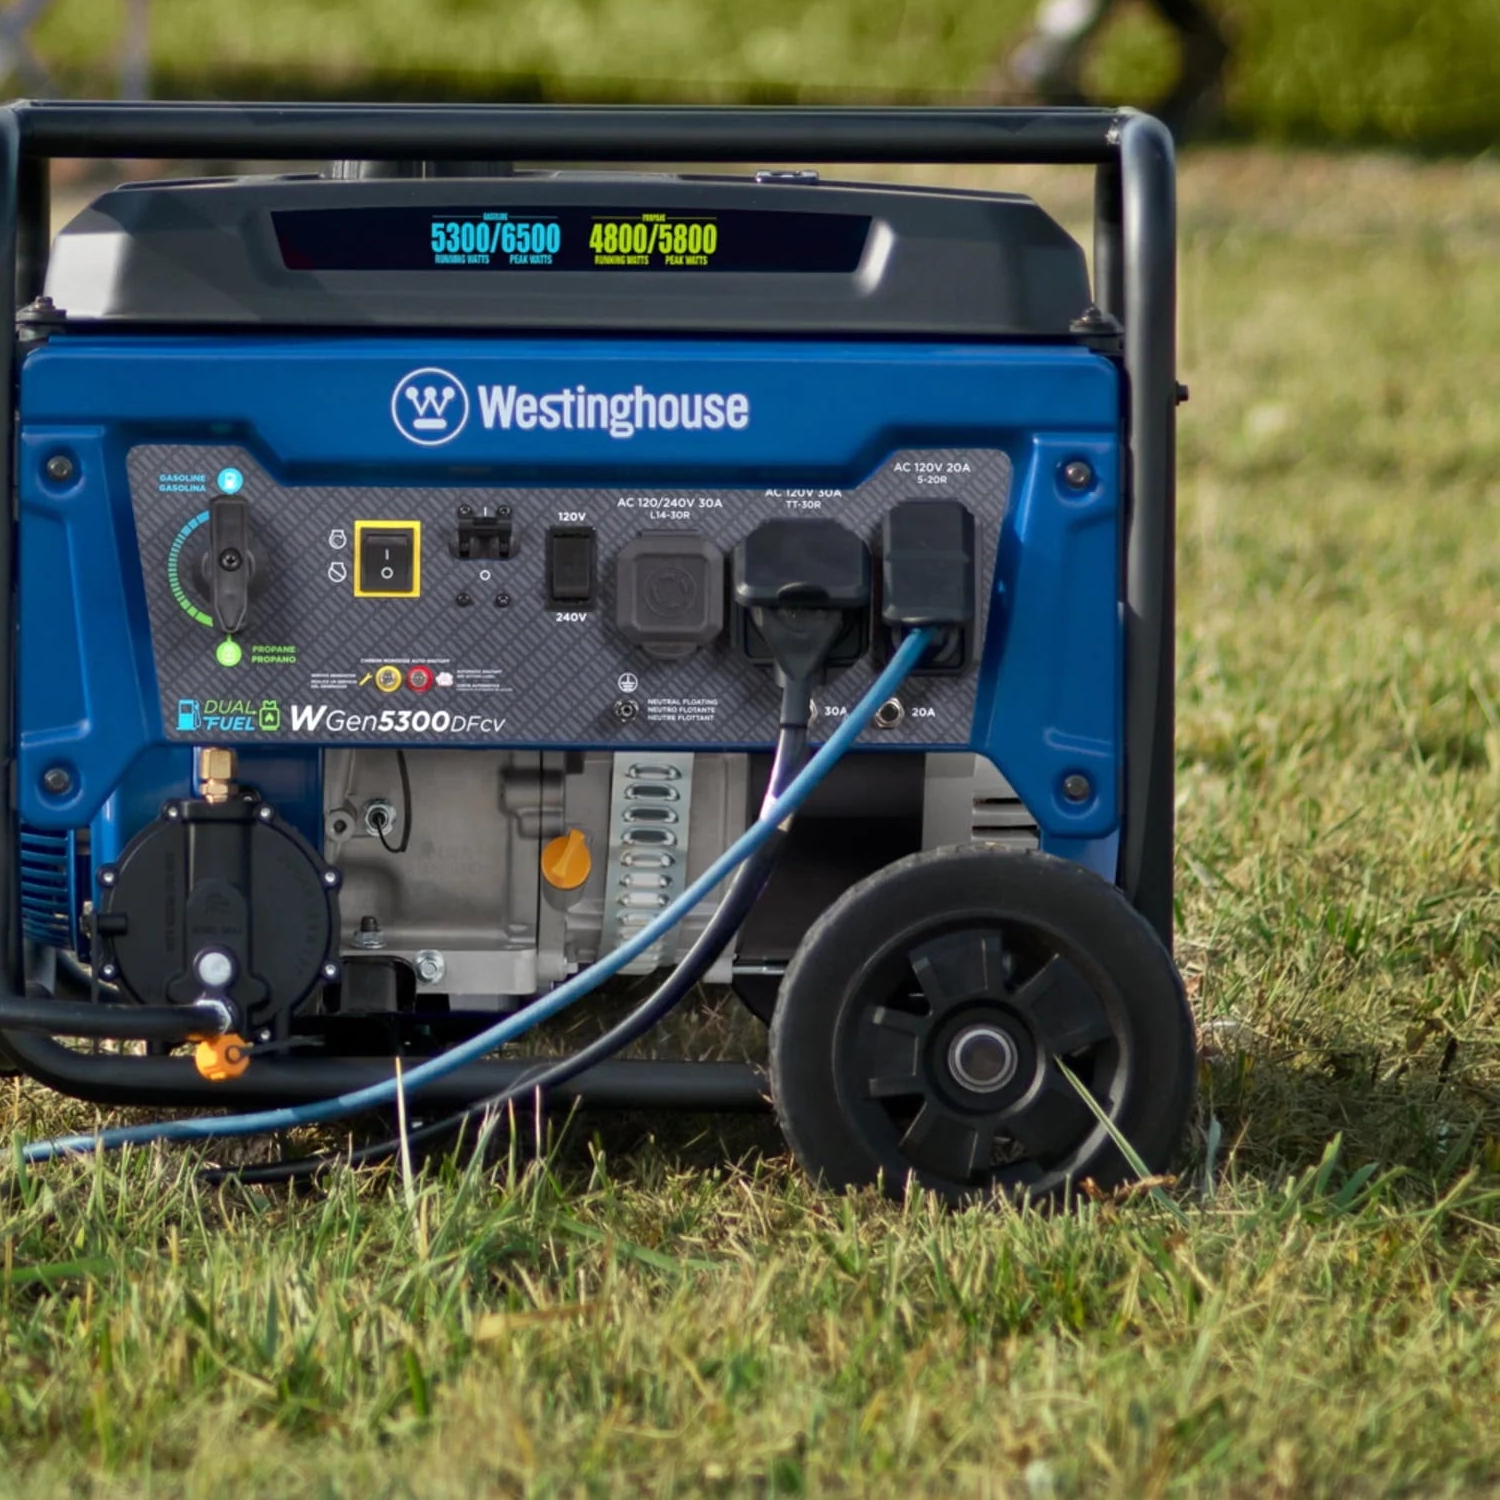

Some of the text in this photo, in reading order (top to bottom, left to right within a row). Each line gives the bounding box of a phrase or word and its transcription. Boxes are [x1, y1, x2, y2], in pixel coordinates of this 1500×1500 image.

[431, 222, 560, 253] 5300/6500
[589, 223, 717, 254] 4800/5800
[509, 254, 528, 264] PEAK
[665, 255, 684, 265] PEAK
[477, 385, 749, 438] Westinghouse
[893, 463, 971, 473] AC 120V 20A
[159, 474, 206, 482] GASOLINE
[917, 475, 947, 484] 5-20R
[158, 484, 206, 492] GASOLINA
[765, 489, 781, 497] AC
[786, 489, 814, 497] 120V
[617, 498, 723, 508] AC 120/240V 30A
[786, 500, 821, 509] TT-30R
[558, 512, 586, 521] 120V
[650, 511, 690, 520] L14-30R
[555, 613, 587, 622] 240V
[252, 645, 296, 653] PROPANE
[203, 699, 255, 714] DUAL
[824, 706, 847, 716] 30A
[911, 707, 936, 717] 20A
[202, 716, 255, 731] FUEL
